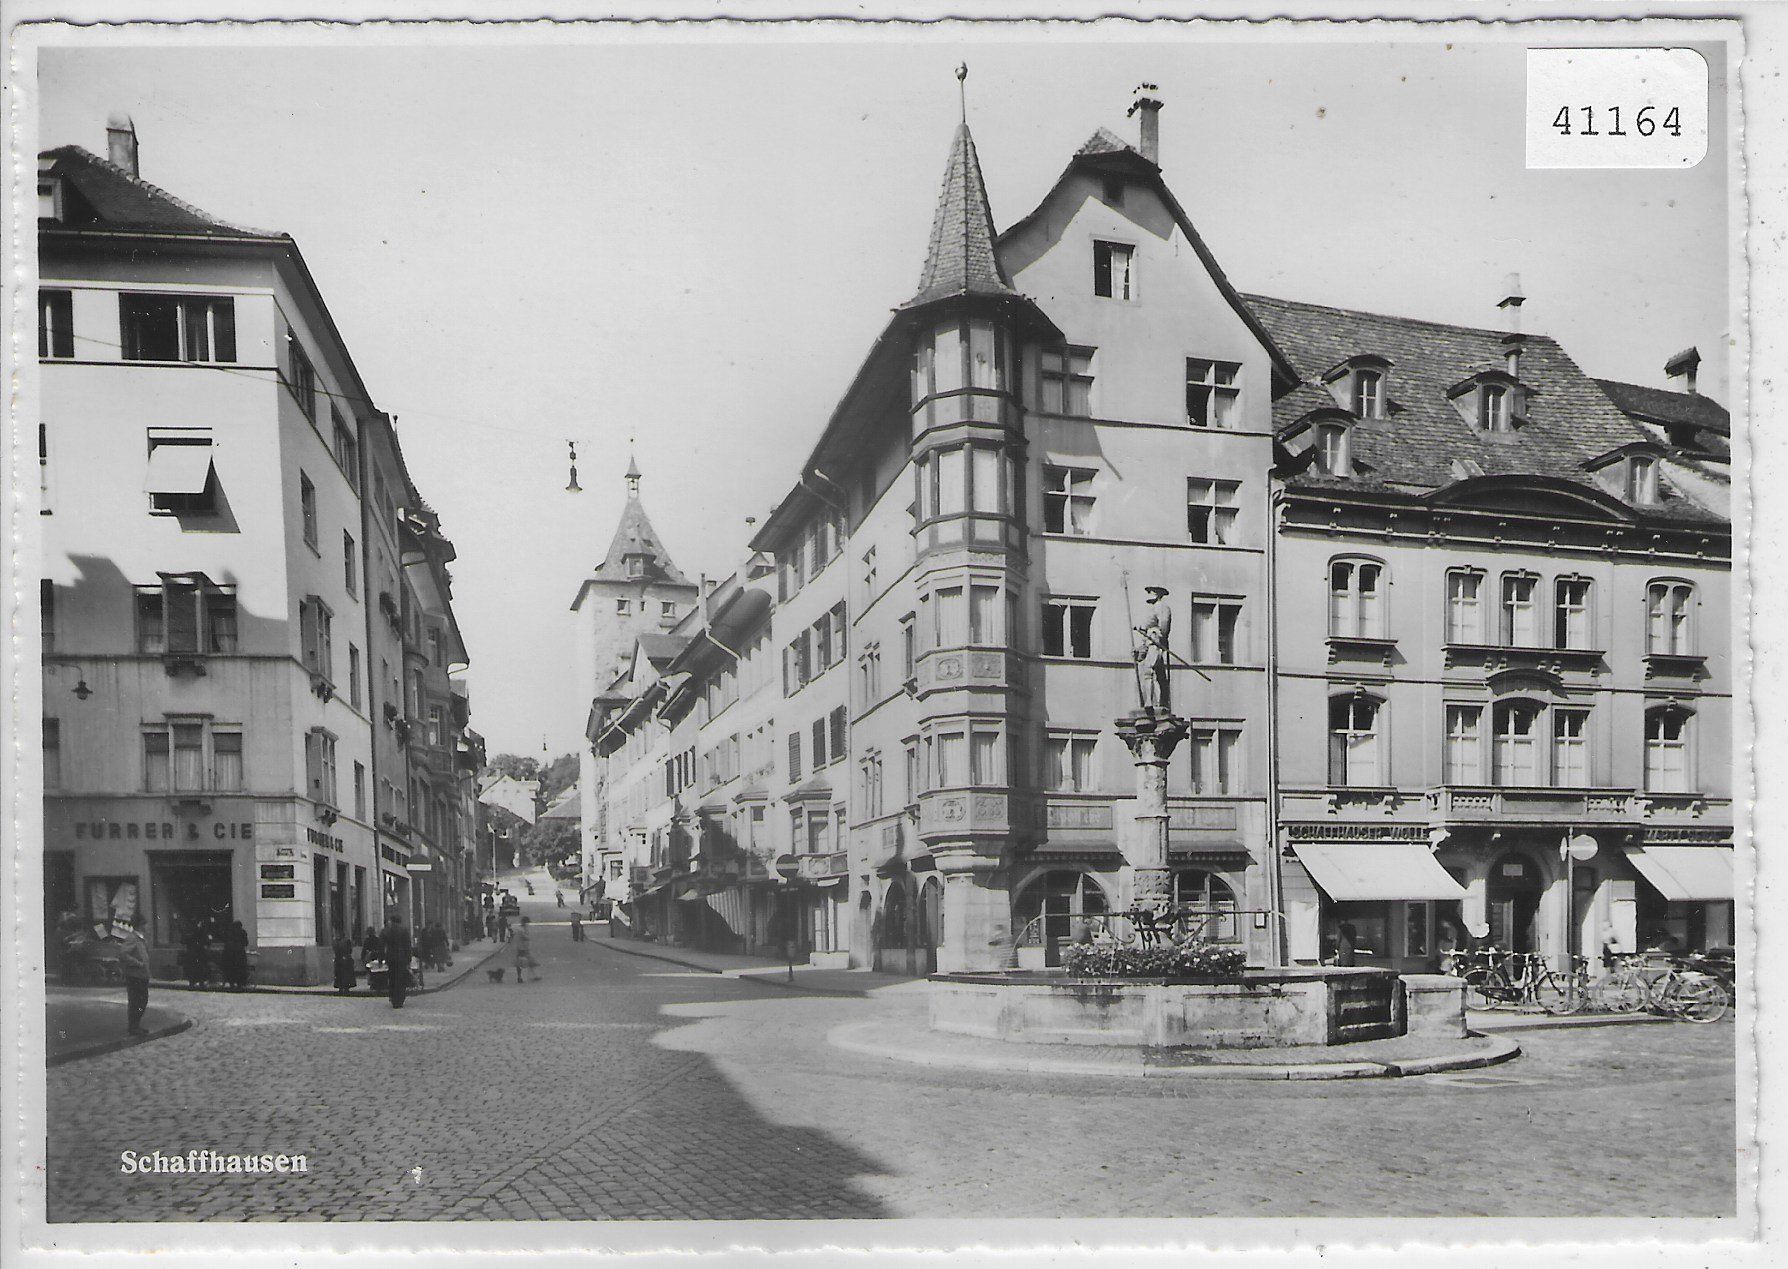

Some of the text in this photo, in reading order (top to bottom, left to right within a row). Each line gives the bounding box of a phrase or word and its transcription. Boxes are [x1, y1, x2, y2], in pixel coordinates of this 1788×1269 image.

[75, 822, 253, 840] FURRER & CIE
